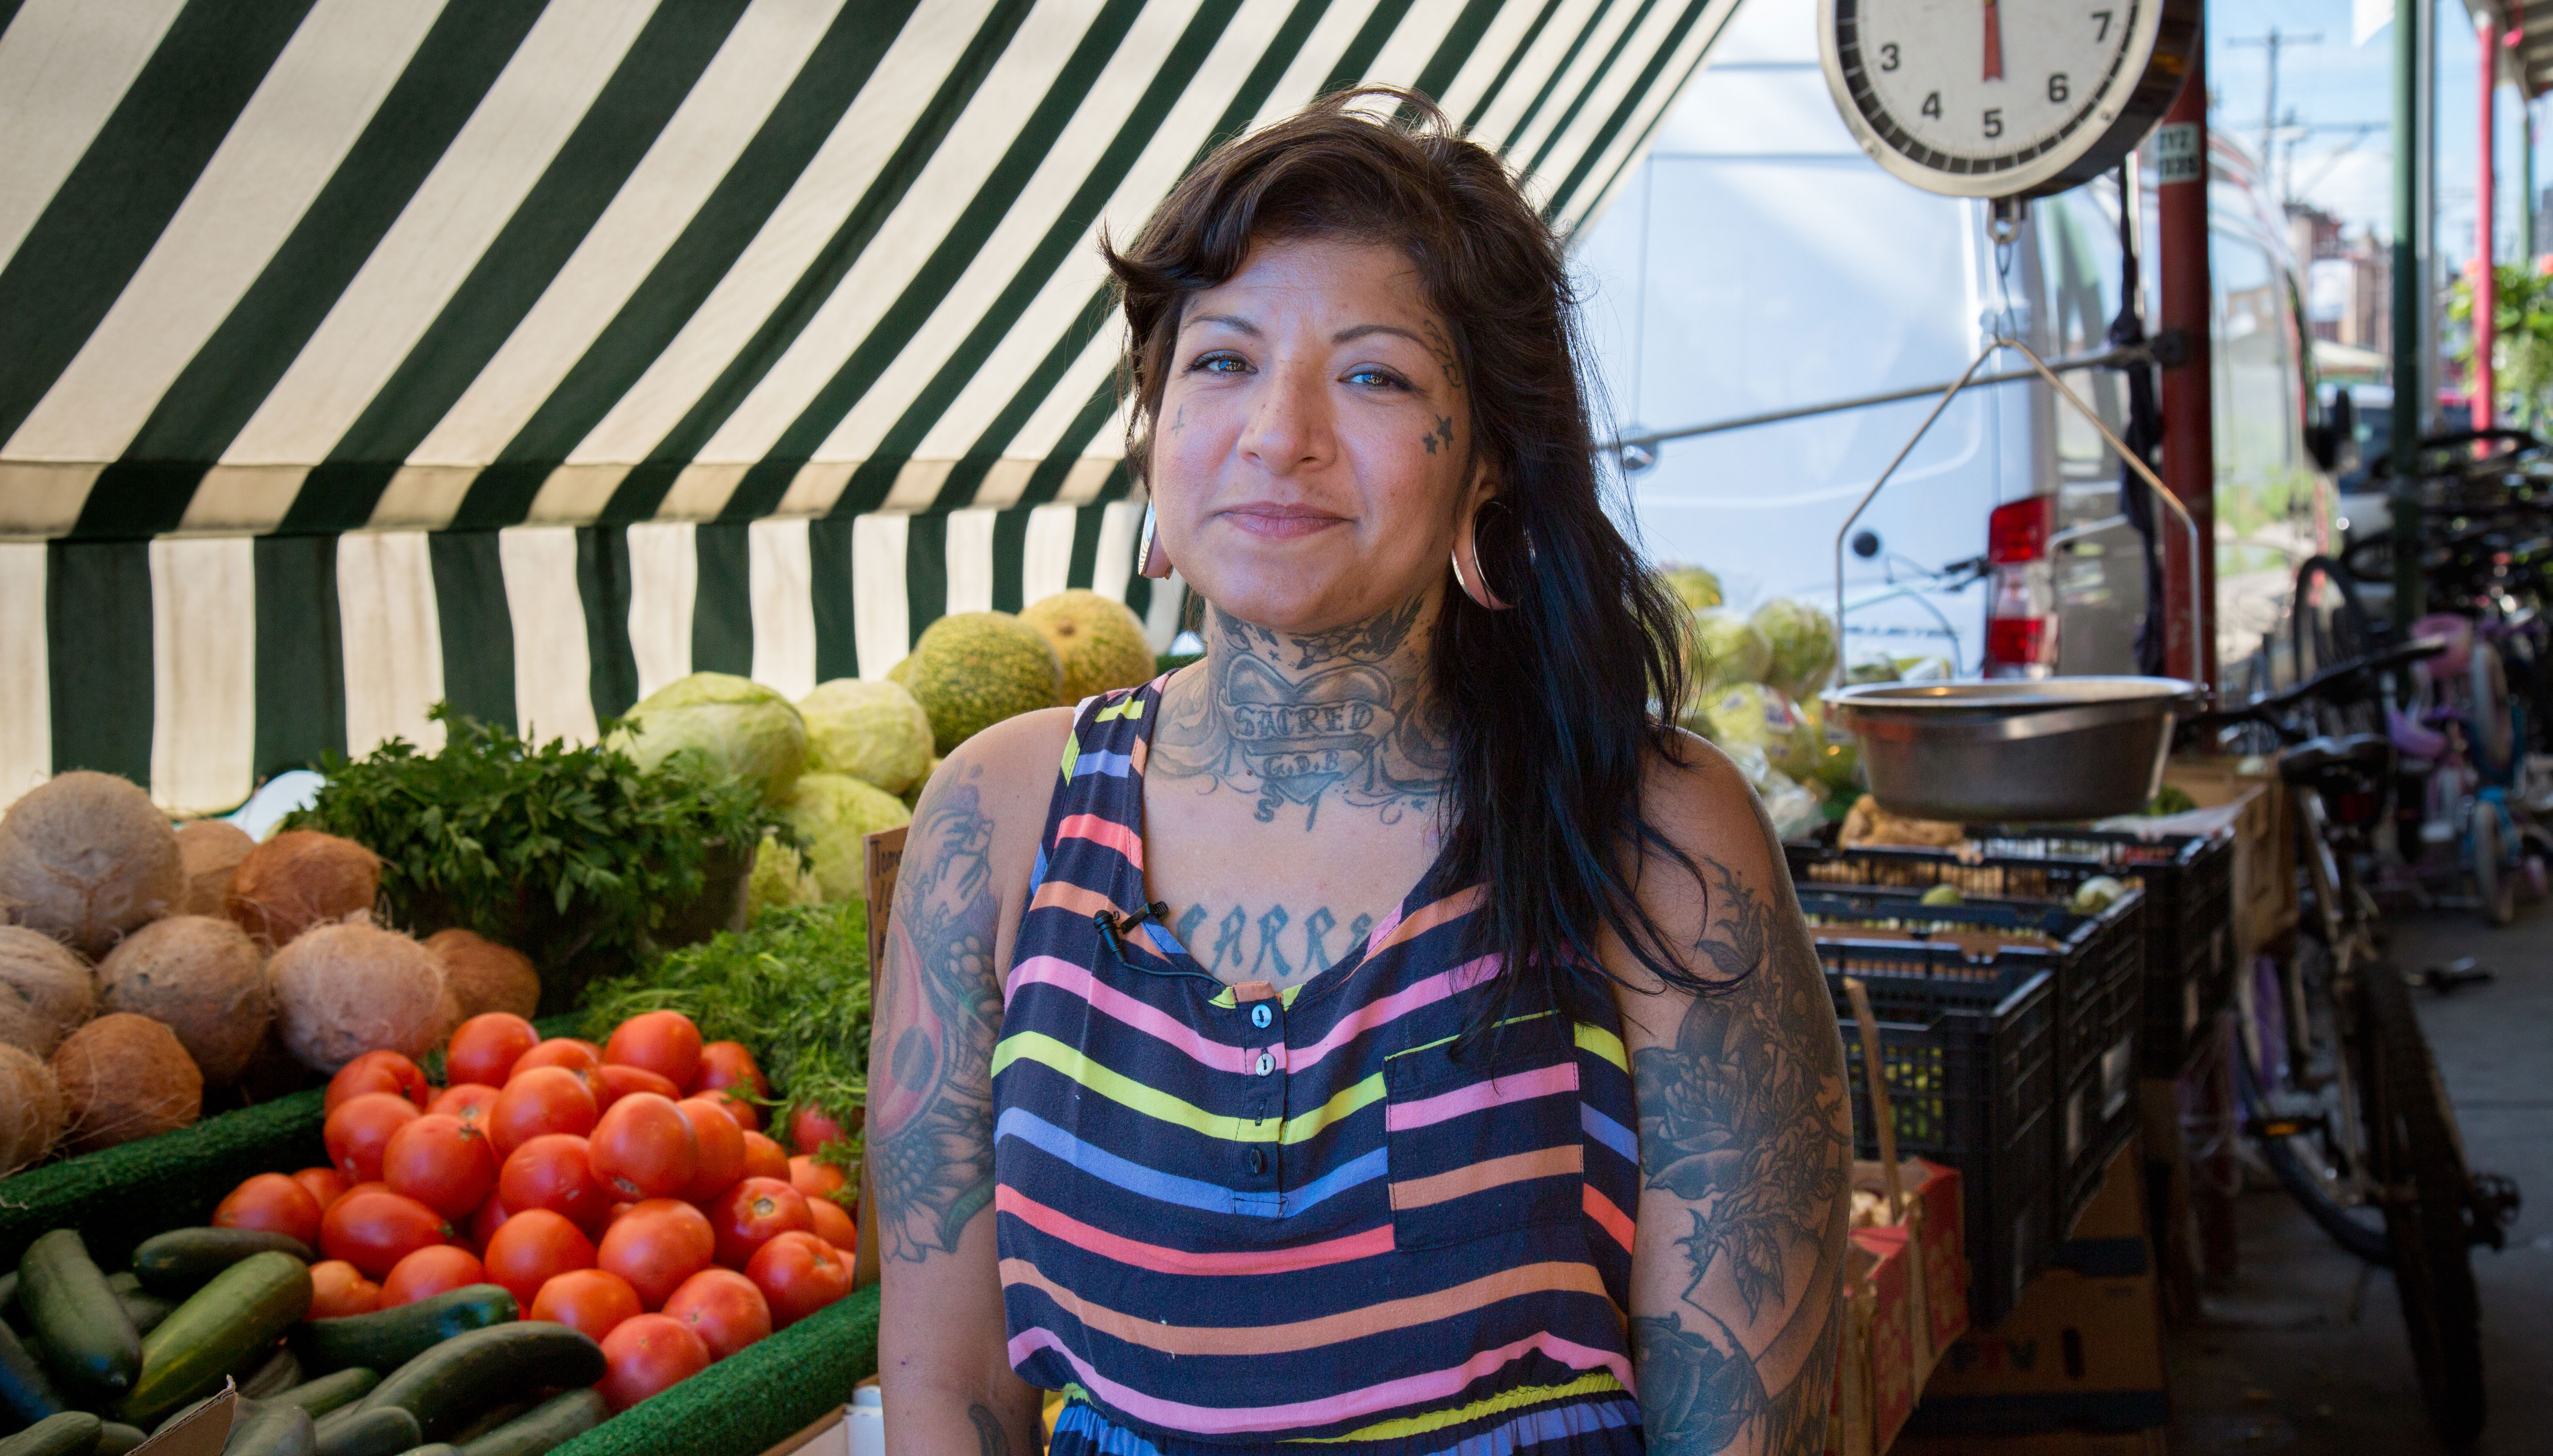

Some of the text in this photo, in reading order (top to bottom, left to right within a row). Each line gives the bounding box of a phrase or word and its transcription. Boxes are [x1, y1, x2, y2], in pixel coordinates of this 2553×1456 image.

[2091, 12, 2112, 43] 7
[1881, 43, 1900, 71] 3
[2048, 72, 2069, 103] 6
[1921, 91, 1942, 120] 4
[1983, 109, 2004, 138] 5
[1234, 702, 1374, 737] SACRED
